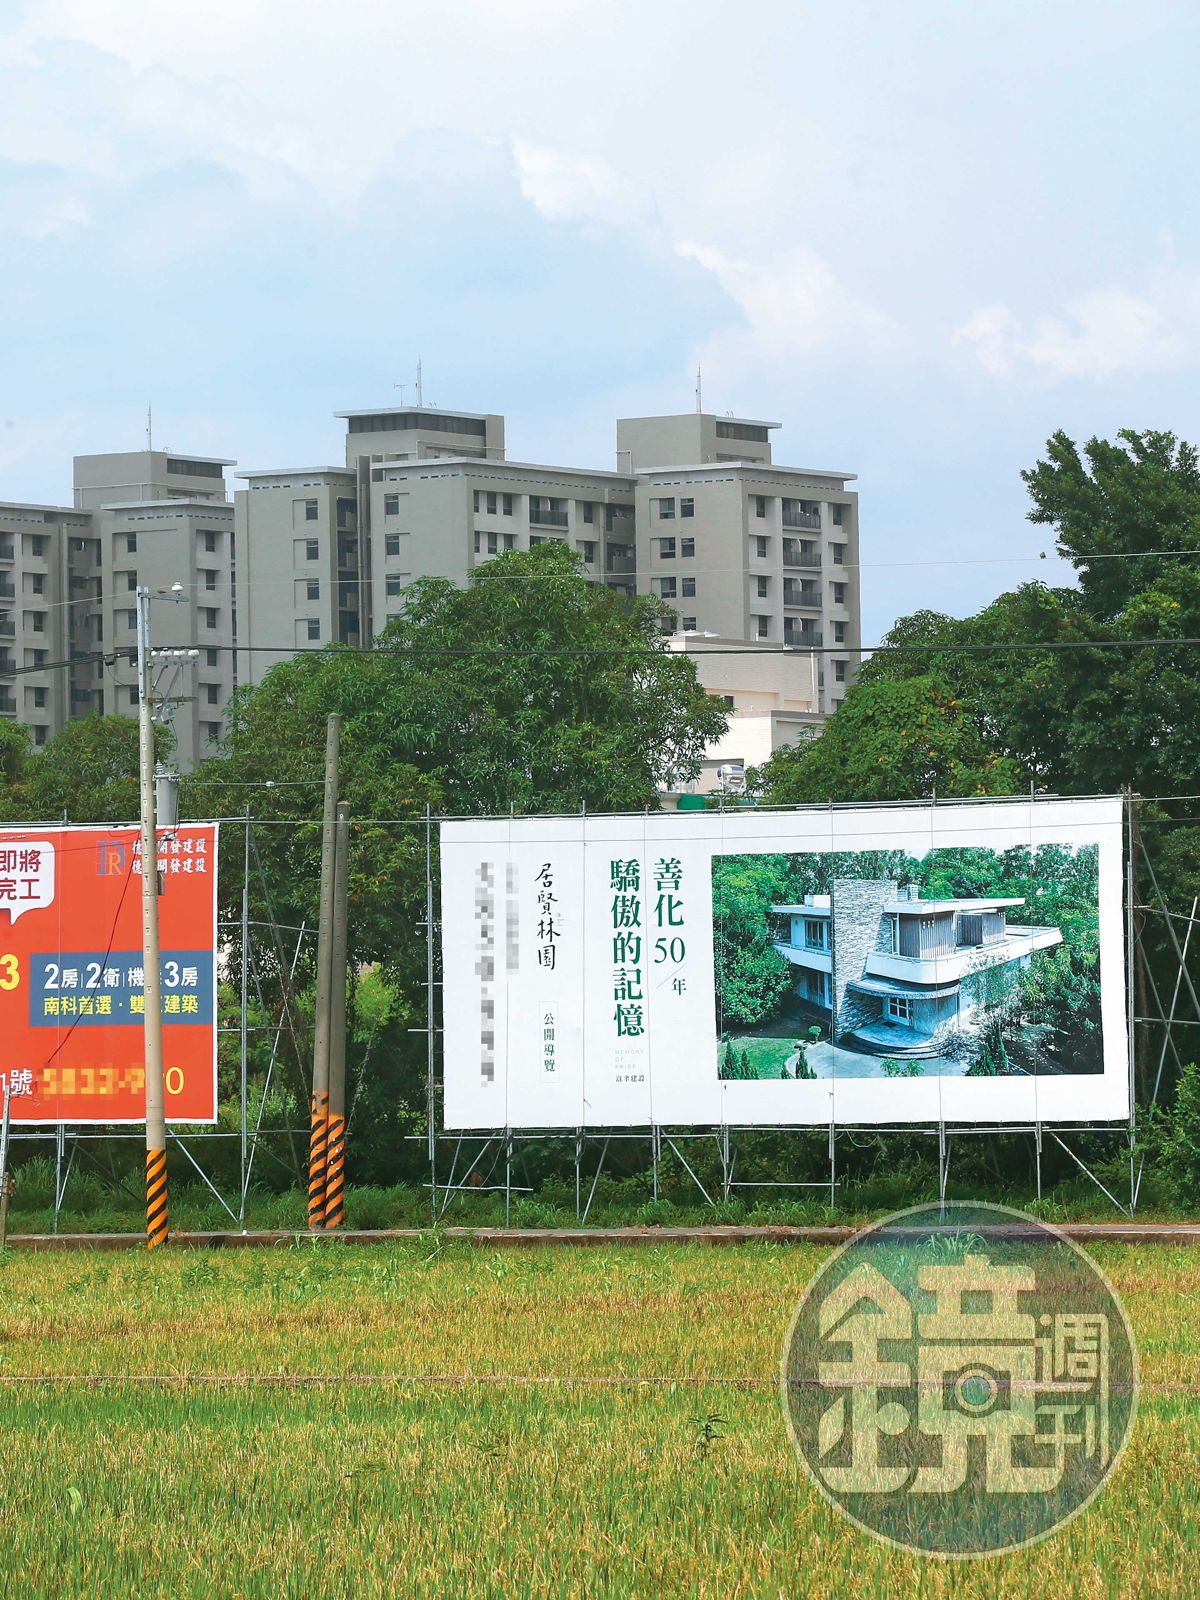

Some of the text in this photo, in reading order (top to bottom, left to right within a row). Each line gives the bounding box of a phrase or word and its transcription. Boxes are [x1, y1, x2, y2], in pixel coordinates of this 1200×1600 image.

[132, 838, 207, 854] 德開發建設
[132, 858, 207, 874] 德開發建設
[610, 859, 645, 1037] 驕傲的記憶
[543, 1013, 555, 1072] 公開導覽
